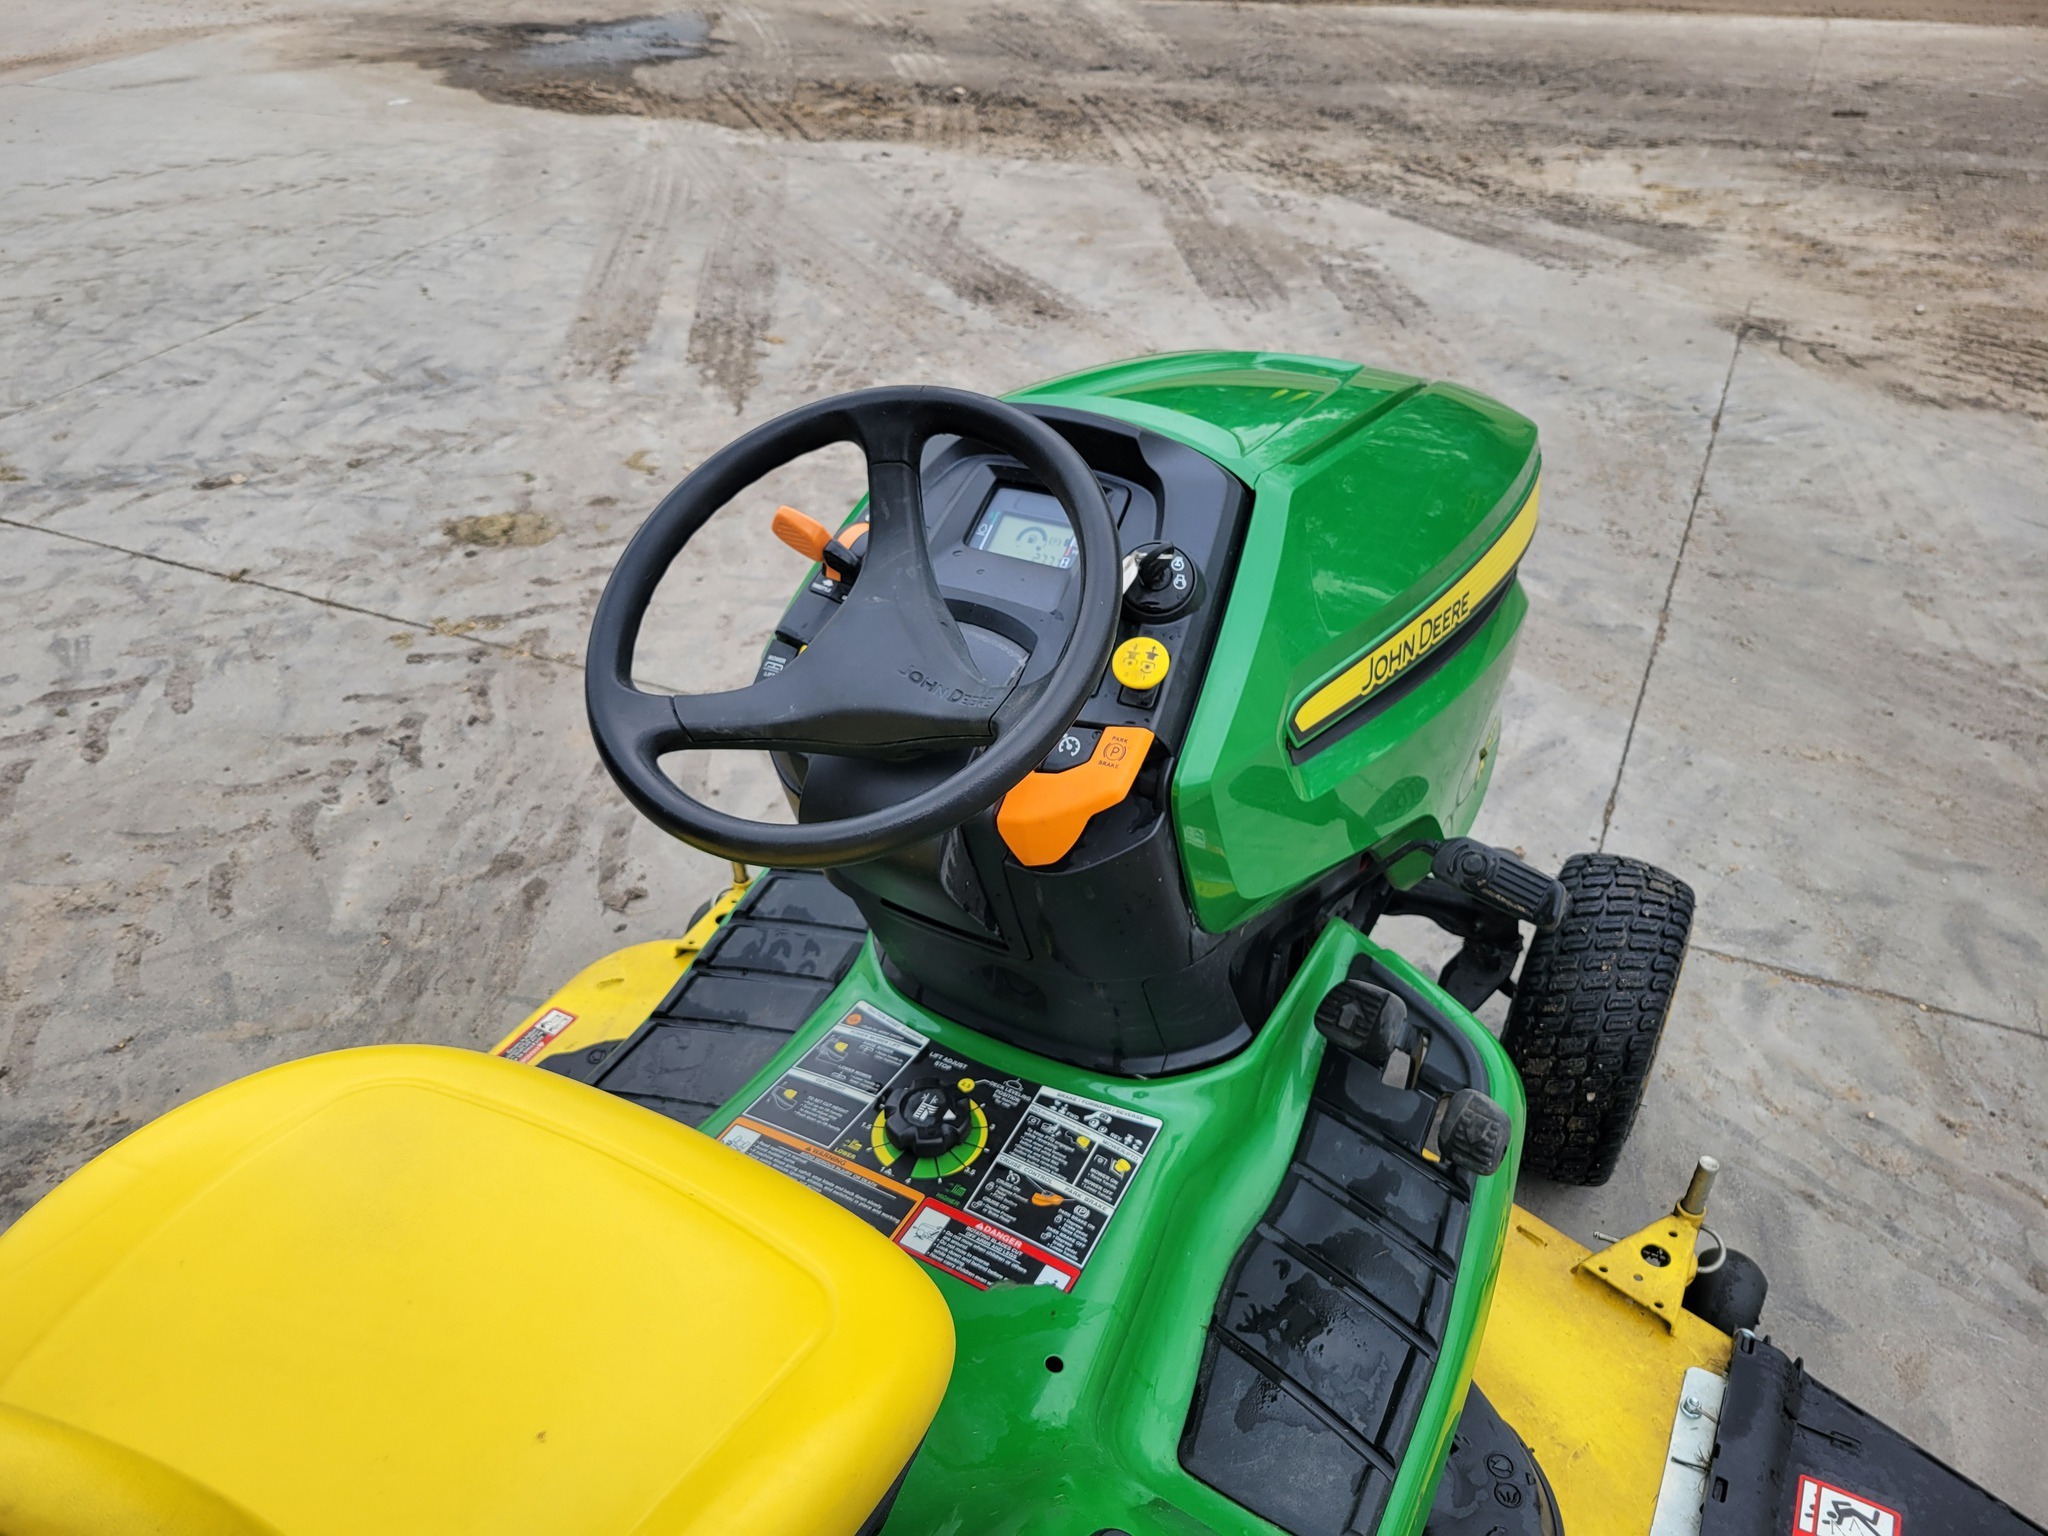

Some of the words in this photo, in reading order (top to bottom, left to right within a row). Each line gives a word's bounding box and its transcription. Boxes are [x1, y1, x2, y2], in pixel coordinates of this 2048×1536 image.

[1362, 633, 1416, 692] JOHN
[1418, 591, 1470, 650] DEERE
[897, 663, 950, 697] JOHN
[946, 686, 995, 709] DEERE
[1111, 735, 1129, 744] PARK
[1098, 759, 1120, 770] BRAKE
[929, 1050, 942, 1060] LIFT
[942, 1056, 967, 1070] ADJUST
[934, 1059, 952, 1071] STOP
[826, 1081, 845, 1091] HEIGHT
[961, 1080, 971, 1089] 2.5
[988, 1080, 1005, 1090] DECK
[1004, 1086, 1031, 1102] LEVELING
[994, 1088, 1020, 1102] POSITION
[1056, 1092, 1078, 1102] BRAKE
[1080, 1098, 1111, 1111] FORWARD
[1115, 1108, 1143, 1120] REVERSE
[1065, 1110, 1079, 1120] FWD
[861, 1122, 873, 1130] 1.5
[1109, 1131, 1122, 1141] REV
[811, 1146, 847, 1167] WARNING
[833, 1146, 856, 1160] LOWER
[1101, 1139, 1139, 1161] MOWER/PTO
[815, 1157, 834, 1169] SERIOUS
[833, 1165, 852, 1177] INJURY
[859, 1176, 877, 1188] DEATH
[964, 1167, 977, 1176] 3.5
[998, 1154, 1022, 1169] CRUISE
[1023, 1166, 1054, 1184] CONTROL
[1089, 1167, 1110, 1181] MOWER
[1109, 1177, 1119, 1185] ON
[1082, 1177, 1103, 1191] MOWER
[1102, 1187, 1113, 1196] OFF
[935, 1191, 960, 1207] HIGHER
[1063, 1186, 1082, 1198] PARK
[1083, 1196, 1107, 1211] BRAKE
[1057, 1207, 1071, 1217] PARK
[1070, 1214, 1087, 1226] BRAKE
[1086, 1222, 1095, 1230] ON
[950, 1238, 968, 1250] around
[965, 1225, 990, 1241] ROTATING
[989, 1237, 1011, 1251] BLADES
[1010, 1247, 1023, 1256] CUT
[965, 1231, 976, 1239] OFF
[975, 1236, 991, 1247] ARMS
[990, 1243, 1002, 1252] AND
[1002, 1249, 1017, 1259] LEGS
[982, 1224, 1023, 1249] DANGER
[1045, 1225, 1059, 1235] PARK
[1058, 1231, 1076, 1243] BRAKE
[1074, 1240, 1086, 1248] OFF
[932, 1247, 946, 1257] while
[944, 1253, 965, 1267] backing
[935, 1243, 949, 1252] Look
[947, 1249, 962, 1259] down
[961, 1256, 971, 1264] and
[969, 1260, 988, 1272] behind
[986, 1268, 1003, 1280] before
[938, 1238, 947, 1246] Do
[946, 1242, 955, 1250] not
[954, 1246, 967, 1255] mow
[971, 1255, 990, 1267] reverse
[952, 1233, 961, 1241] not
[960, 1238, 973, 1247] mow
[972, 1243, 986, 1253] when
[984, 1250, 1005, 1263] children
[1010, 1262, 1027, 1274] others
[928, 1251, 944, 1262] Never
[942, 1259, 956, 1269] carry
[954, 1264, 975, 1278] children
[974, 1274, 986, 1283] even
